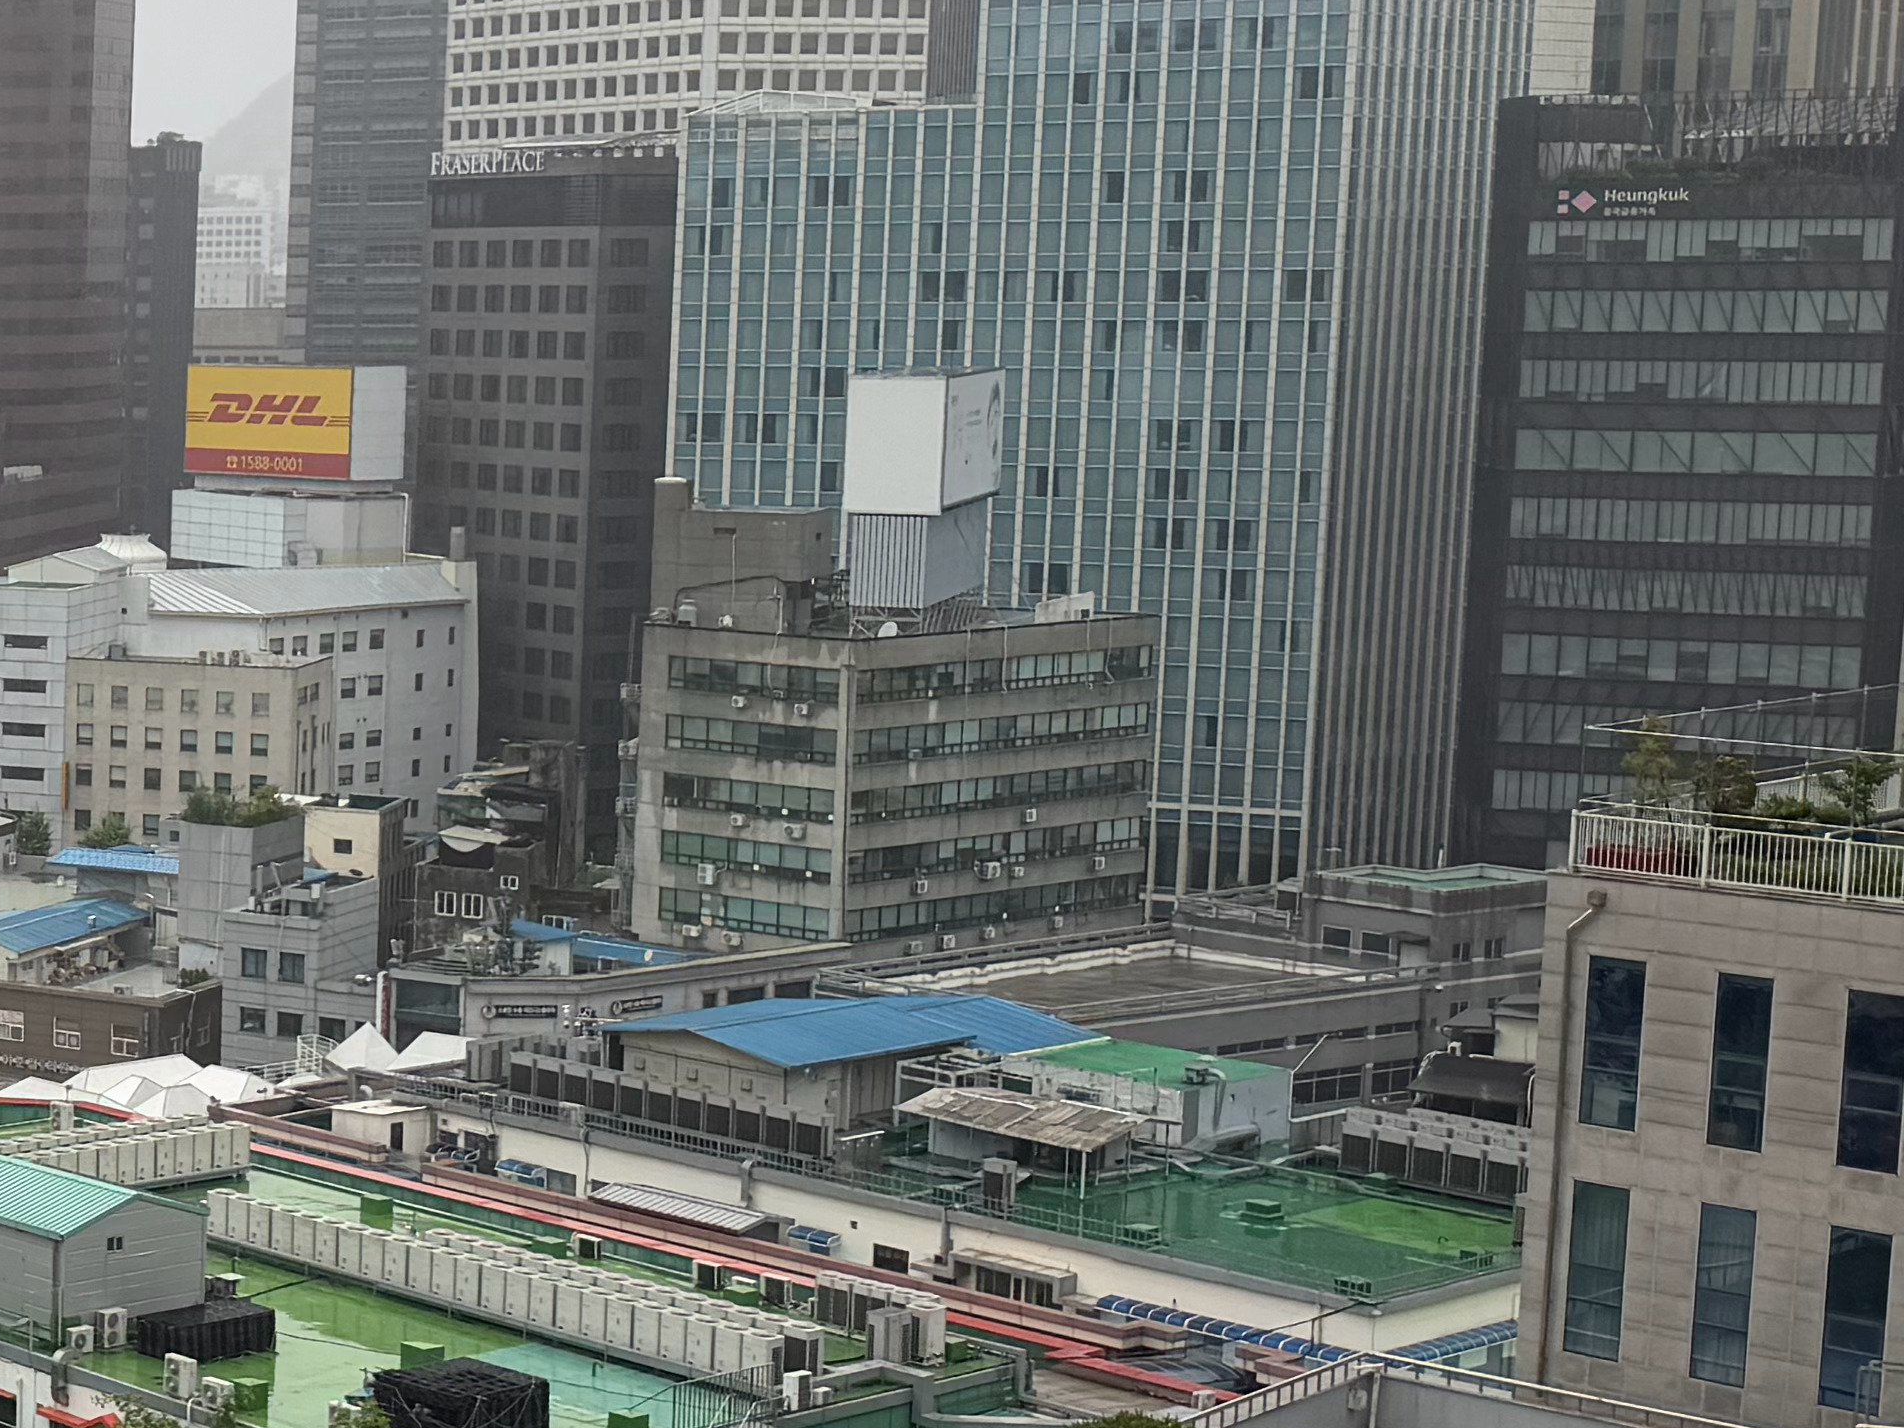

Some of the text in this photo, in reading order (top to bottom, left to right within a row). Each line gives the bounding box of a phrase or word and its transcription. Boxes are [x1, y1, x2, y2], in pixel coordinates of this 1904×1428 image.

[1604, 187, 1690, 204] Heungkuk
[206, 392, 329, 427] DHL
[241, 454, 303, 472] 1588-0001
